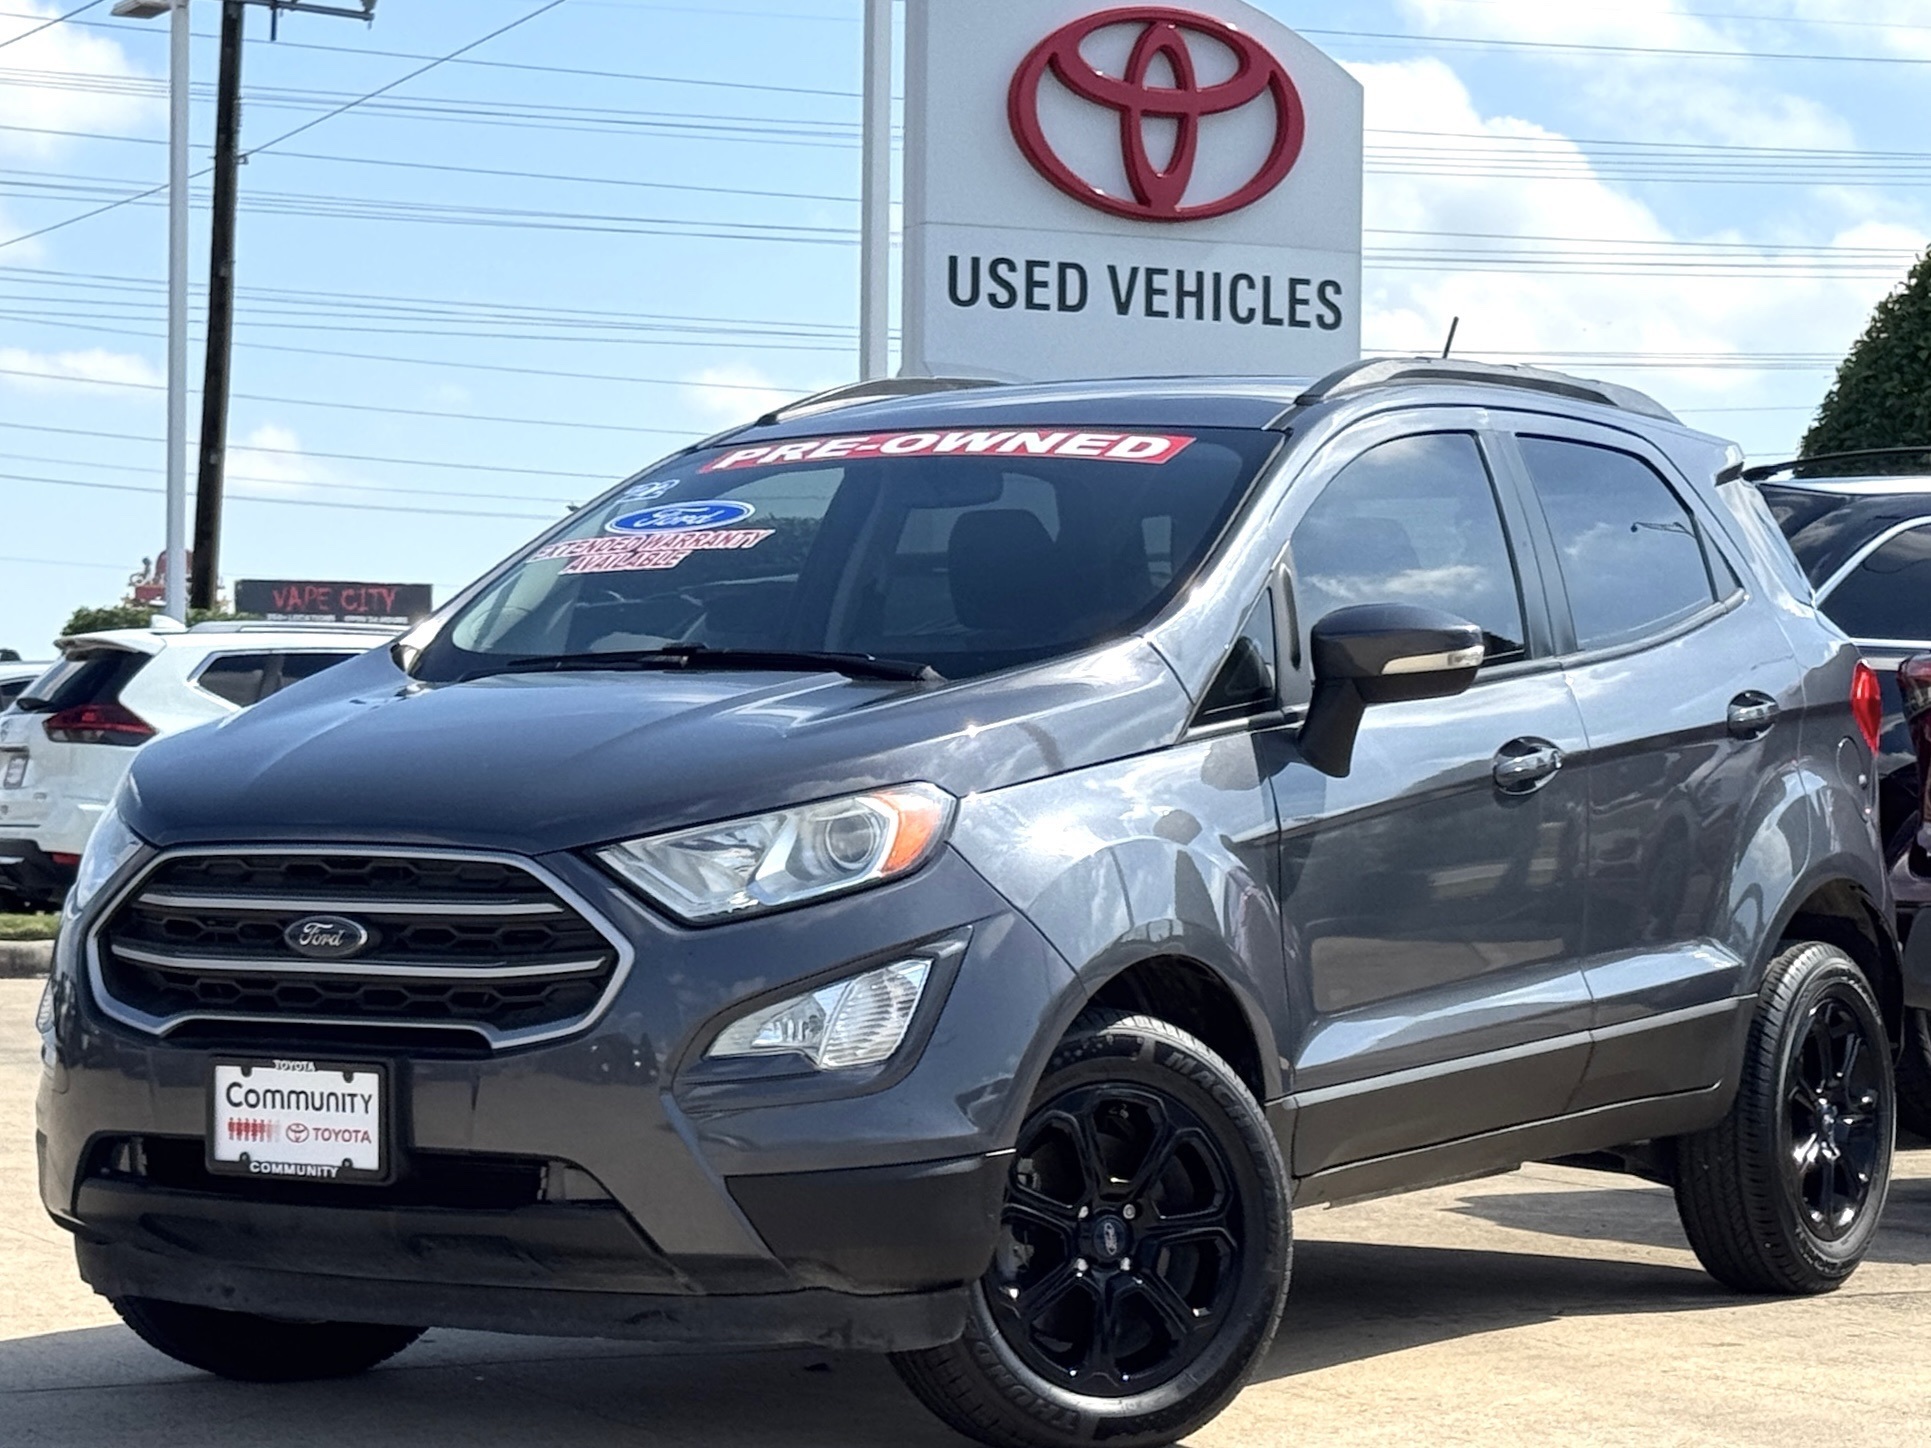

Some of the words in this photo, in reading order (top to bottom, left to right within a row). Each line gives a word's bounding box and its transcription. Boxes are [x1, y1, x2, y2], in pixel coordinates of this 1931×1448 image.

[947, 255, 1089, 313] USED
[1106, 264, 1343, 331] VEHICLES
[711, 431, 1171, 469] PRE-OWNED
[633, 506, 725, 528] Ford
[534, 534, 646, 560] EXTENDED
[640, 529, 769, 550] WARRANTY
[566, 550, 690, 573] AVAILABLE
[272, 586, 332, 611] VAPE
[340, 587, 398, 613] CITY
[299, 922, 346, 947] Ford
[273, 1059, 316, 1072] TOYOTA
[312, 1127, 372, 1144] TOYOTA
[249, 1161, 340, 1178] COMMUNITY
